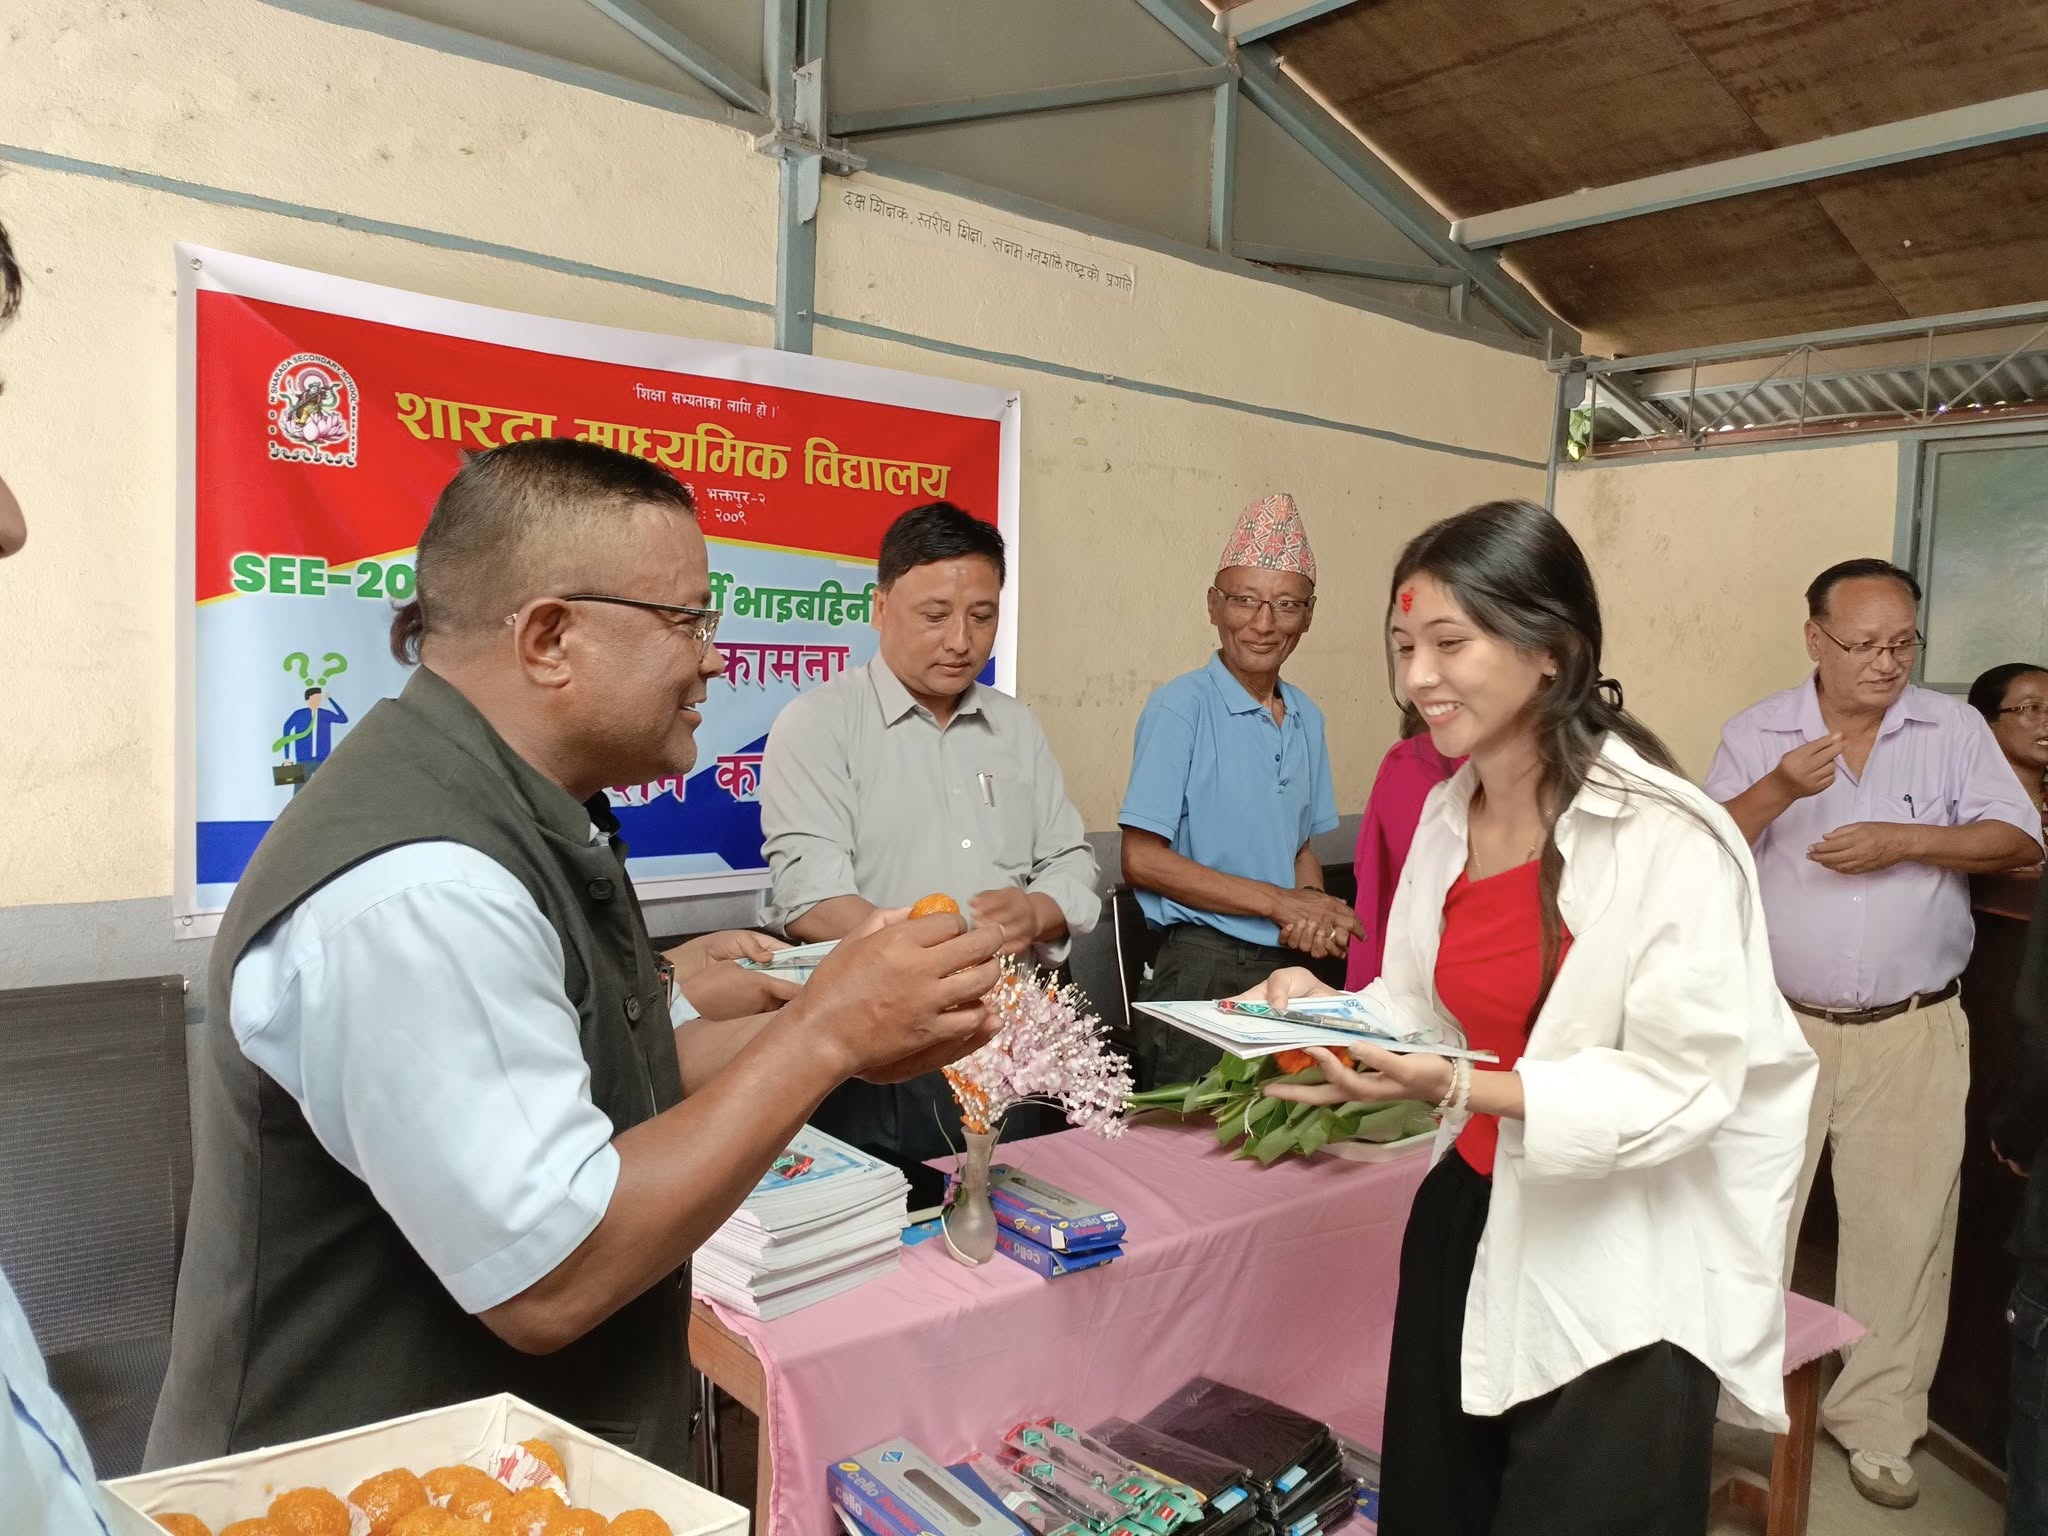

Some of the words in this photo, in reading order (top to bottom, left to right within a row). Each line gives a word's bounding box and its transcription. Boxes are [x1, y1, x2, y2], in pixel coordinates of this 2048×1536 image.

[270, 360, 293, 394] SHARADA
[293, 354, 342, 372] SECONDARY
[342, 372, 358, 403] SCHOOL
[672, 392, 722, 410] सभ्यताका
[727, 397, 752, 414] लागि
[395, 392, 557, 448] शारदा
[573, 418, 792, 480] माध्यमिक
[715, 508, 747, 526] २००९
[232, 554, 417, 600] SEE-20
[713, 642, 850, 690] कामना
